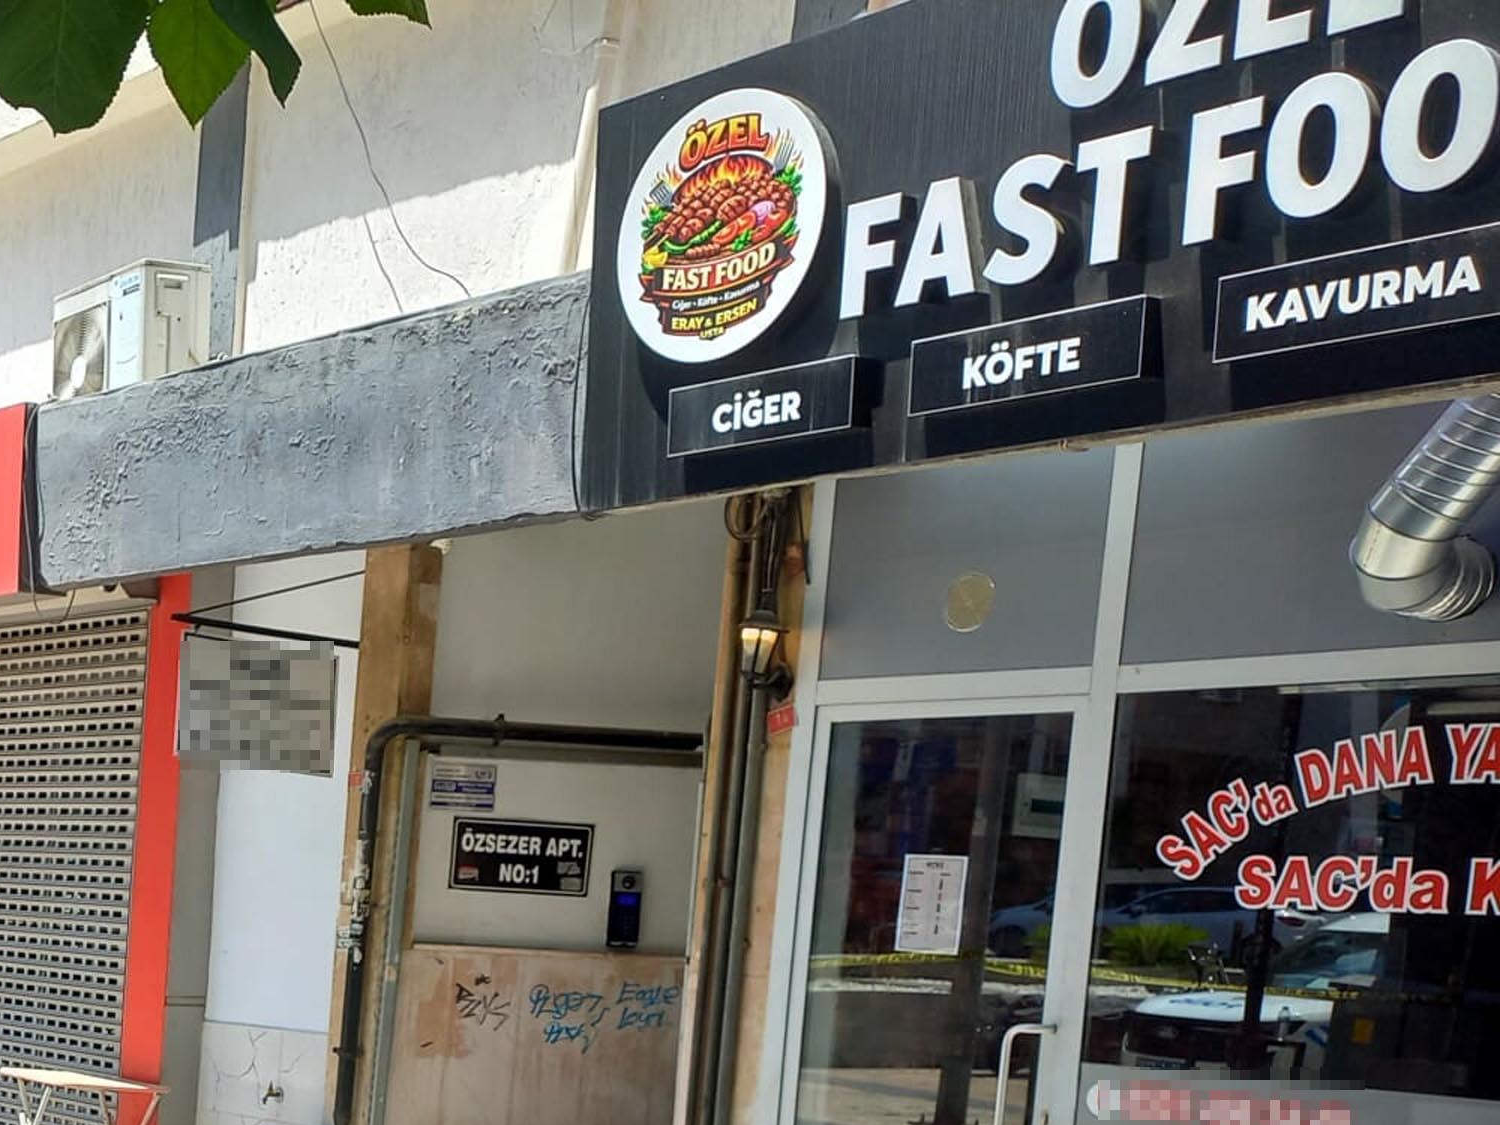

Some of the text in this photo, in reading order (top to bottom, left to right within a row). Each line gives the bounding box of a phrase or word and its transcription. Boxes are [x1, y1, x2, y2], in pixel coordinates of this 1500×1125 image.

[679, 113, 771, 172] ÖZEL
[839, 126, 1154, 321] FAST
[662, 242, 775, 290] FAST FOOD
[671, 315, 704, 330] ERAY
[715, 298, 757, 326] ERSEN
[1244, 256, 1482, 332] KAVURMA
[961, 335, 1082, 391] KÖFTE
[711, 389, 802, 434] CİĞER
[1295, 724, 1435, 808] DANA
[461, 827, 584, 858] ÖZSEZER APT.
[498, 863, 540, 884] NO:1
